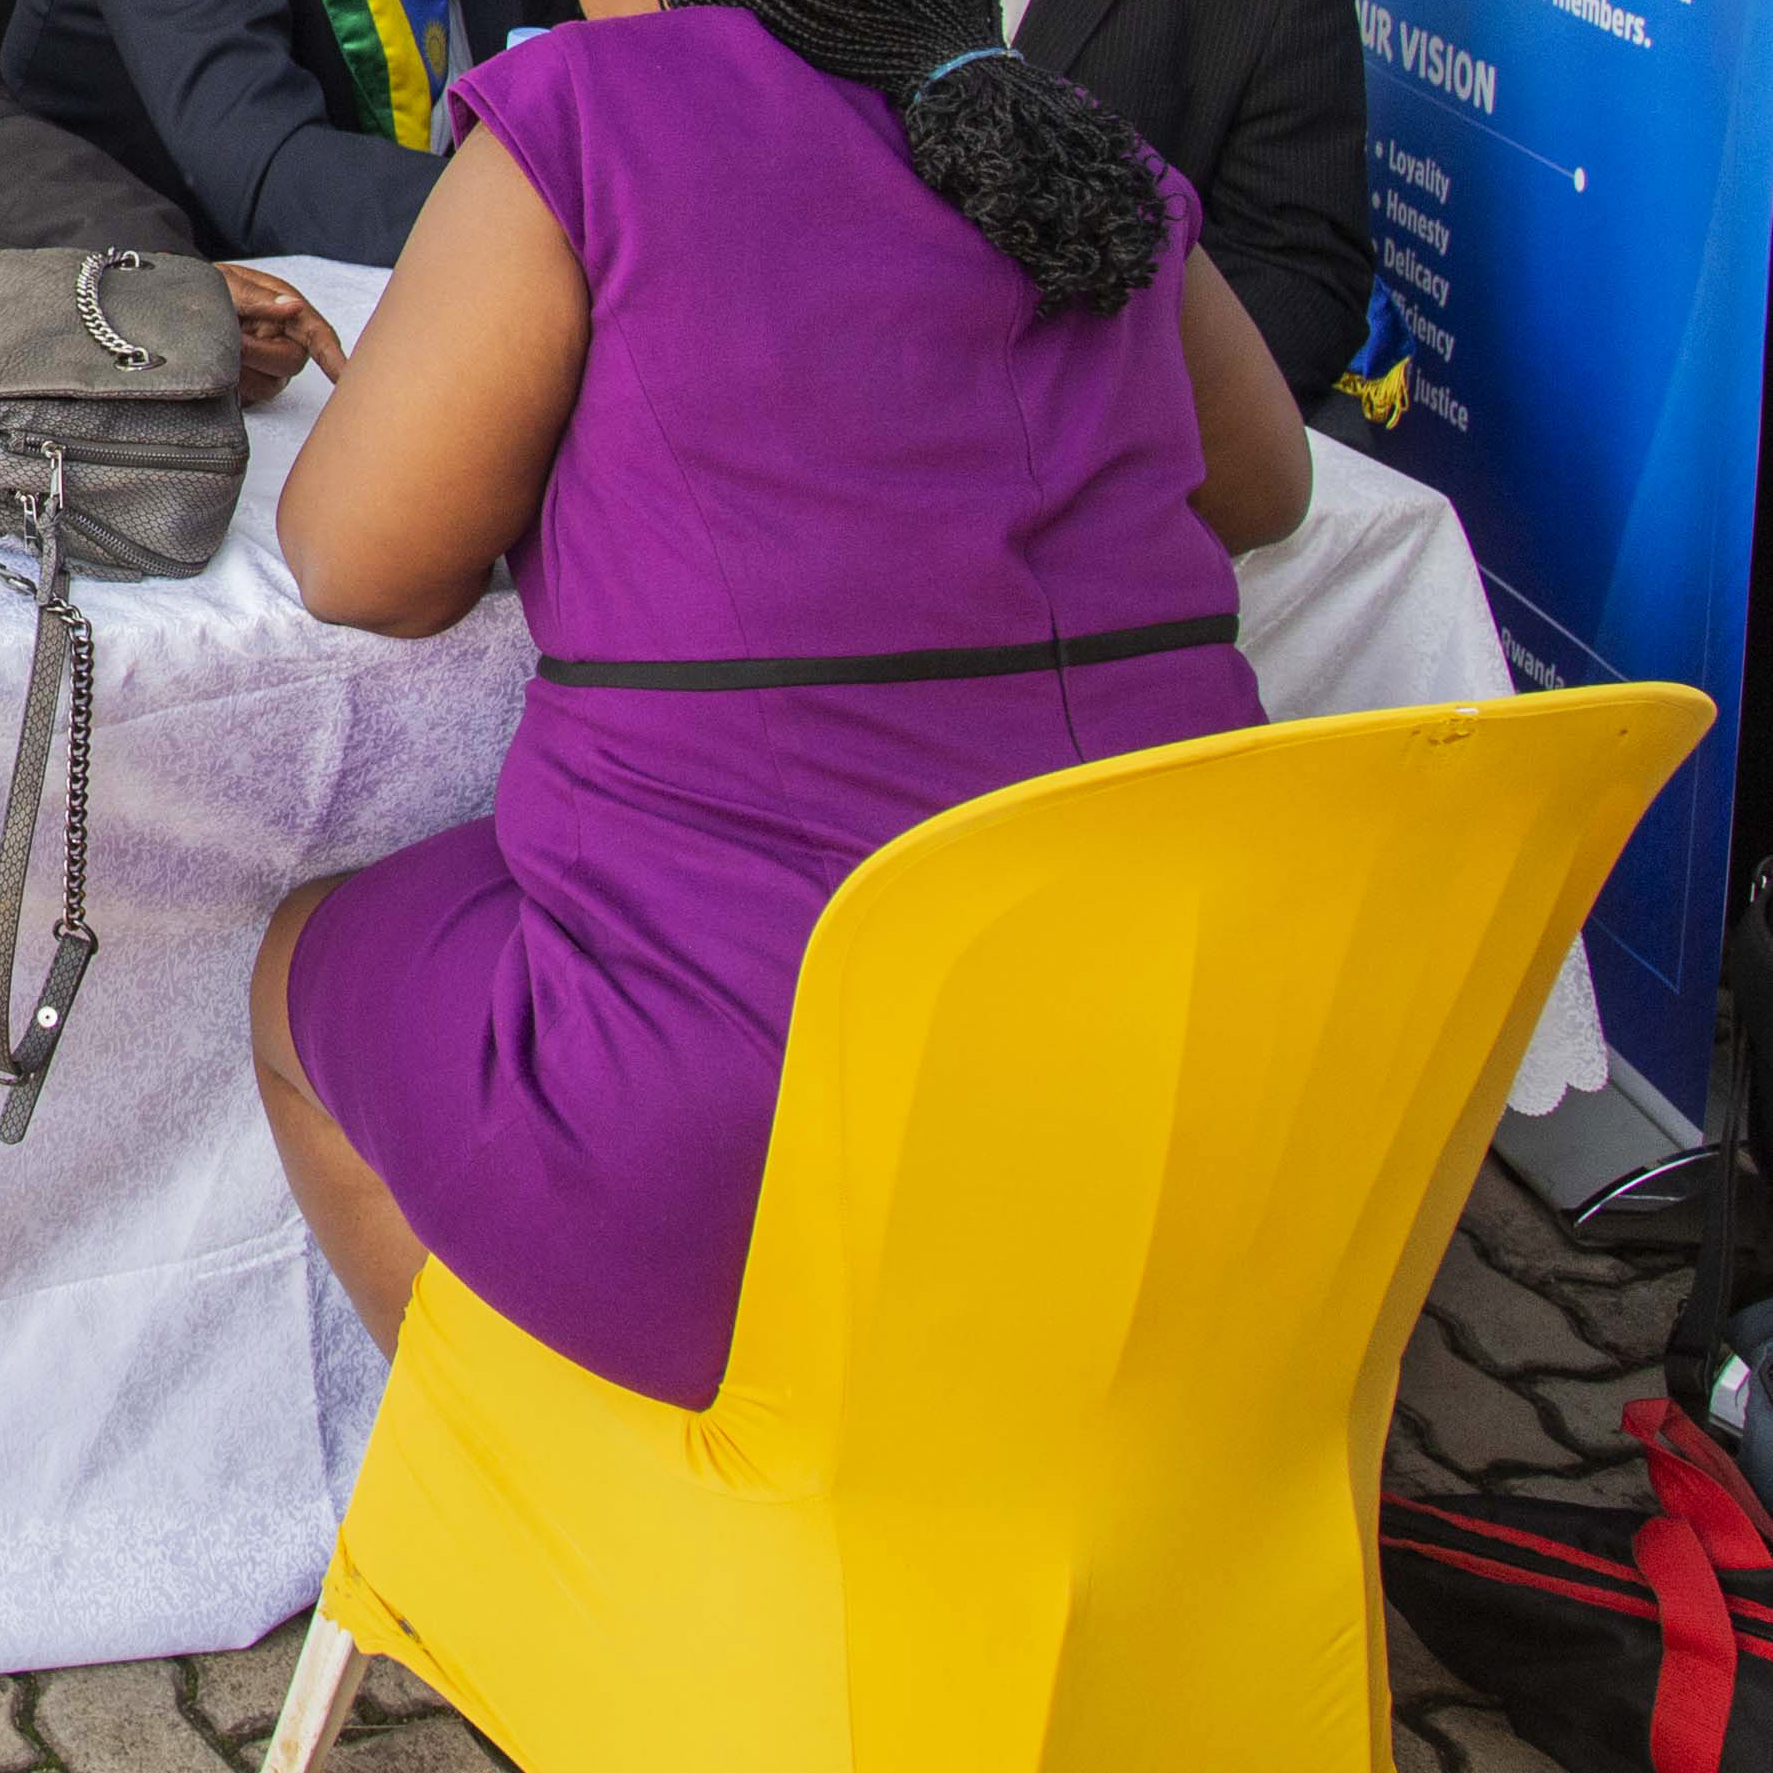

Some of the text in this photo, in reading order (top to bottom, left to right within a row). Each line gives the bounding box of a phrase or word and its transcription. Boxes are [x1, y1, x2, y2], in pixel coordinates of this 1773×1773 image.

[1400, 21, 1495, 114] VISION
[1389, 140, 1449, 204] Loyality
[1387, 189, 1449, 256] Honesty
[1384, 238, 1449, 308] Delicacy
